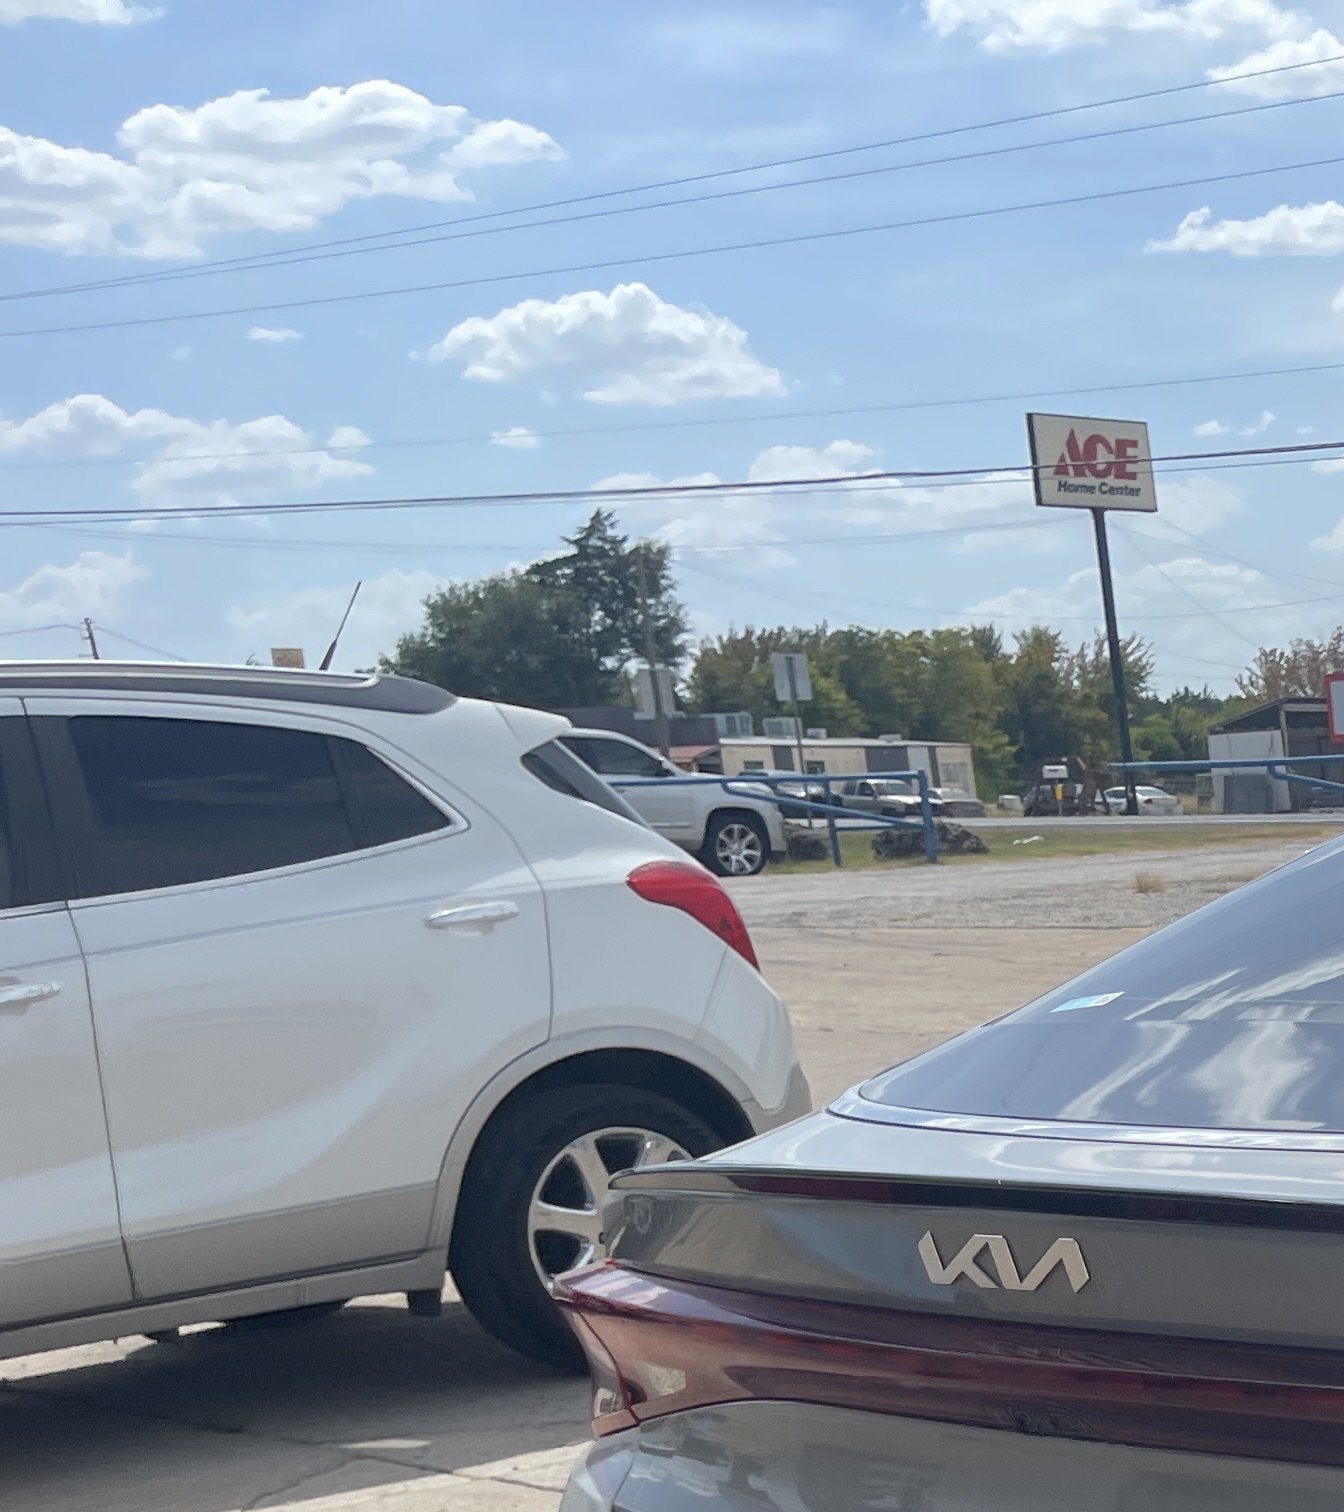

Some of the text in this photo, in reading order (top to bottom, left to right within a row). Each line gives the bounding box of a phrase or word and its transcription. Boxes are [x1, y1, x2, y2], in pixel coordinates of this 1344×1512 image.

[1053, 428, 1139, 480] ACE
[1057, 480, 1141, 497] Home Center
[918, 1230, 1089, 1293] KIA
